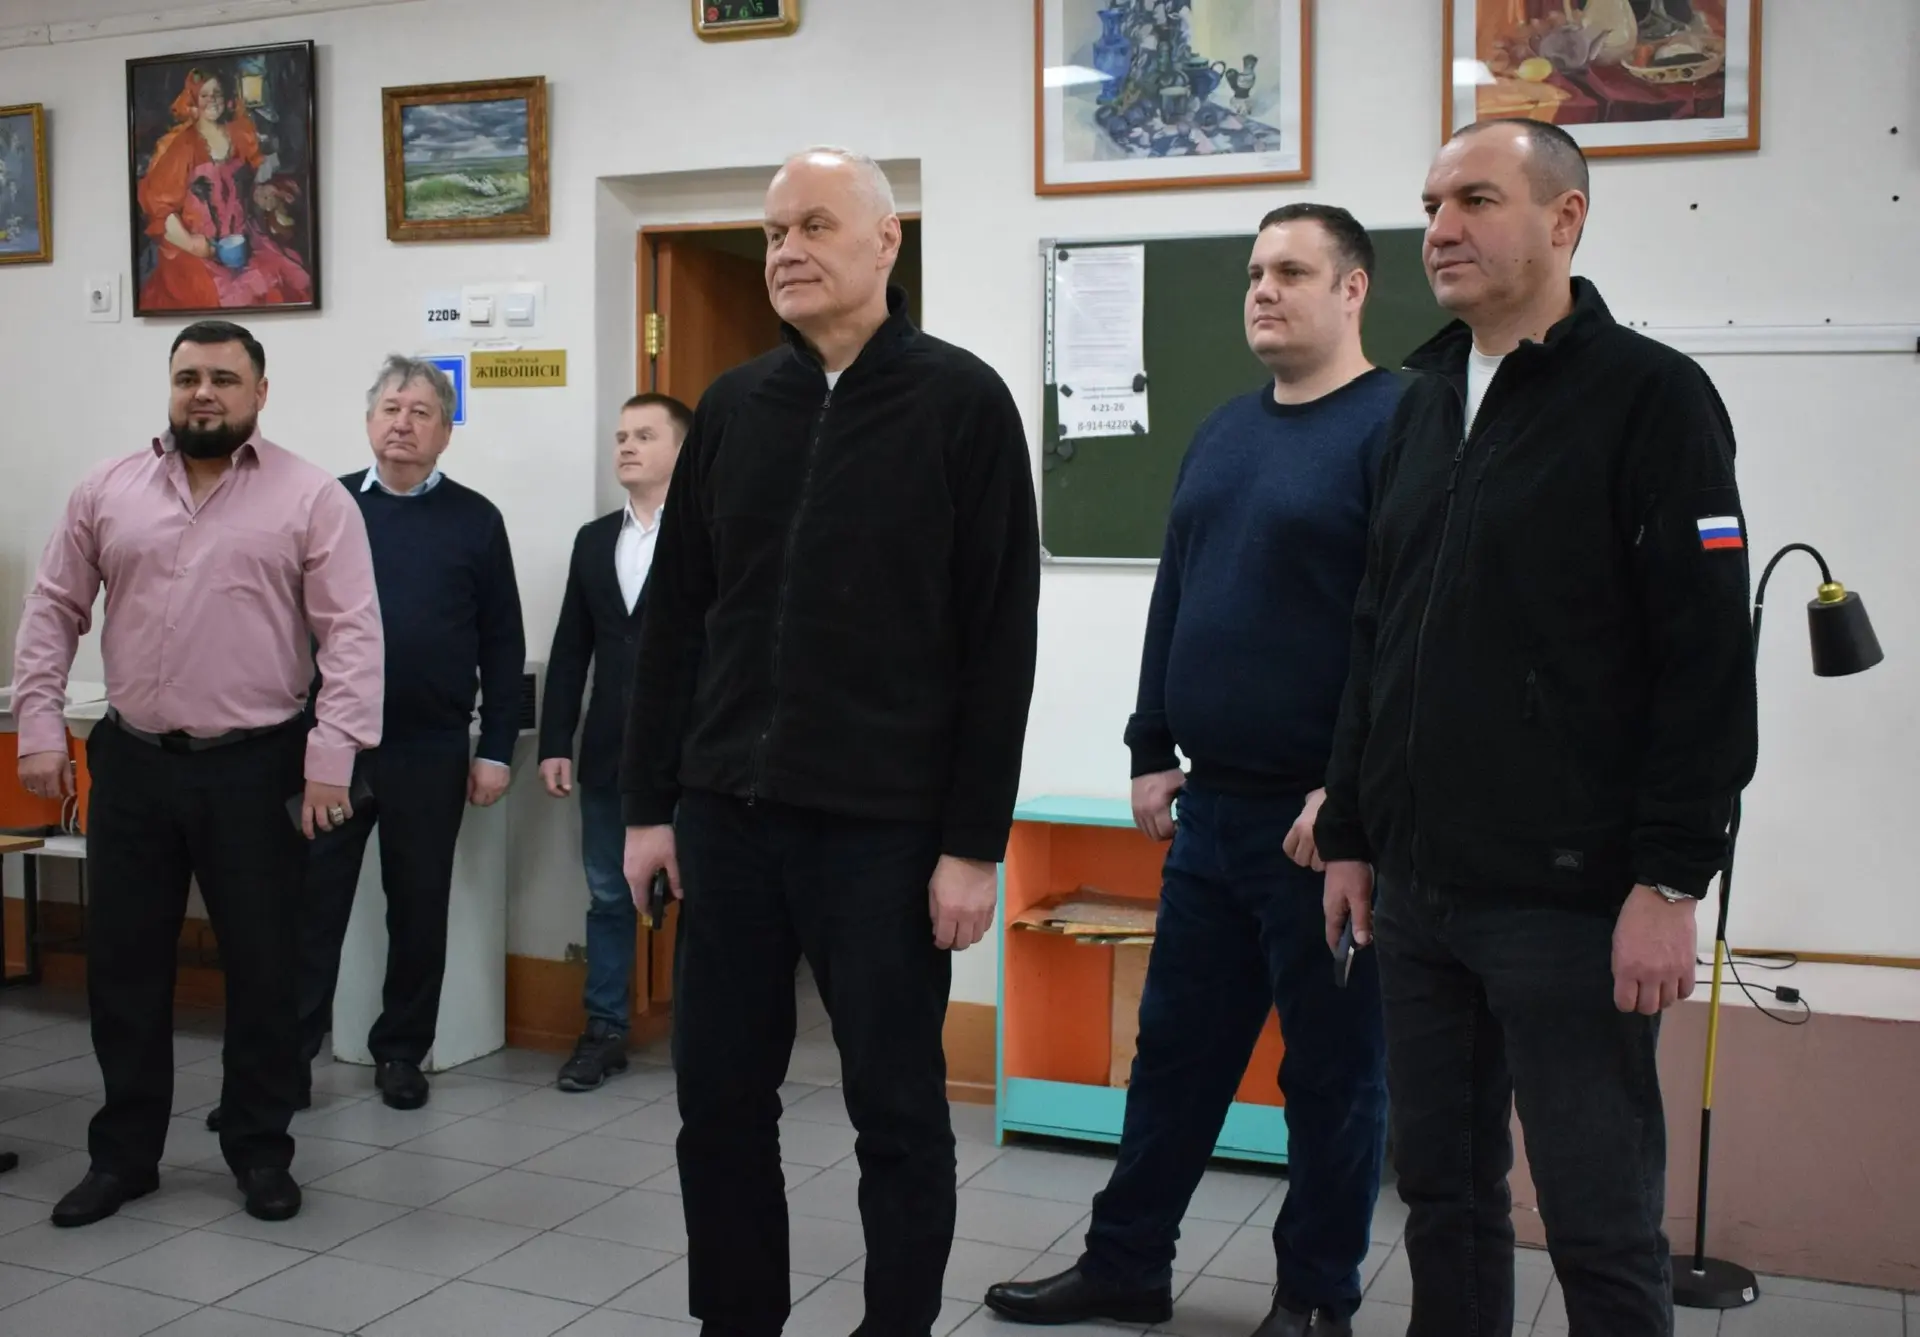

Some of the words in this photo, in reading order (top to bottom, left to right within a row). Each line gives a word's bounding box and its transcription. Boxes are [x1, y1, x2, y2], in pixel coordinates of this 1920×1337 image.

[724, 4, 732, 18] 7
[739, 6, 749, 19] 6
[475, 364, 561, 379] ЖИВОПИСИ
